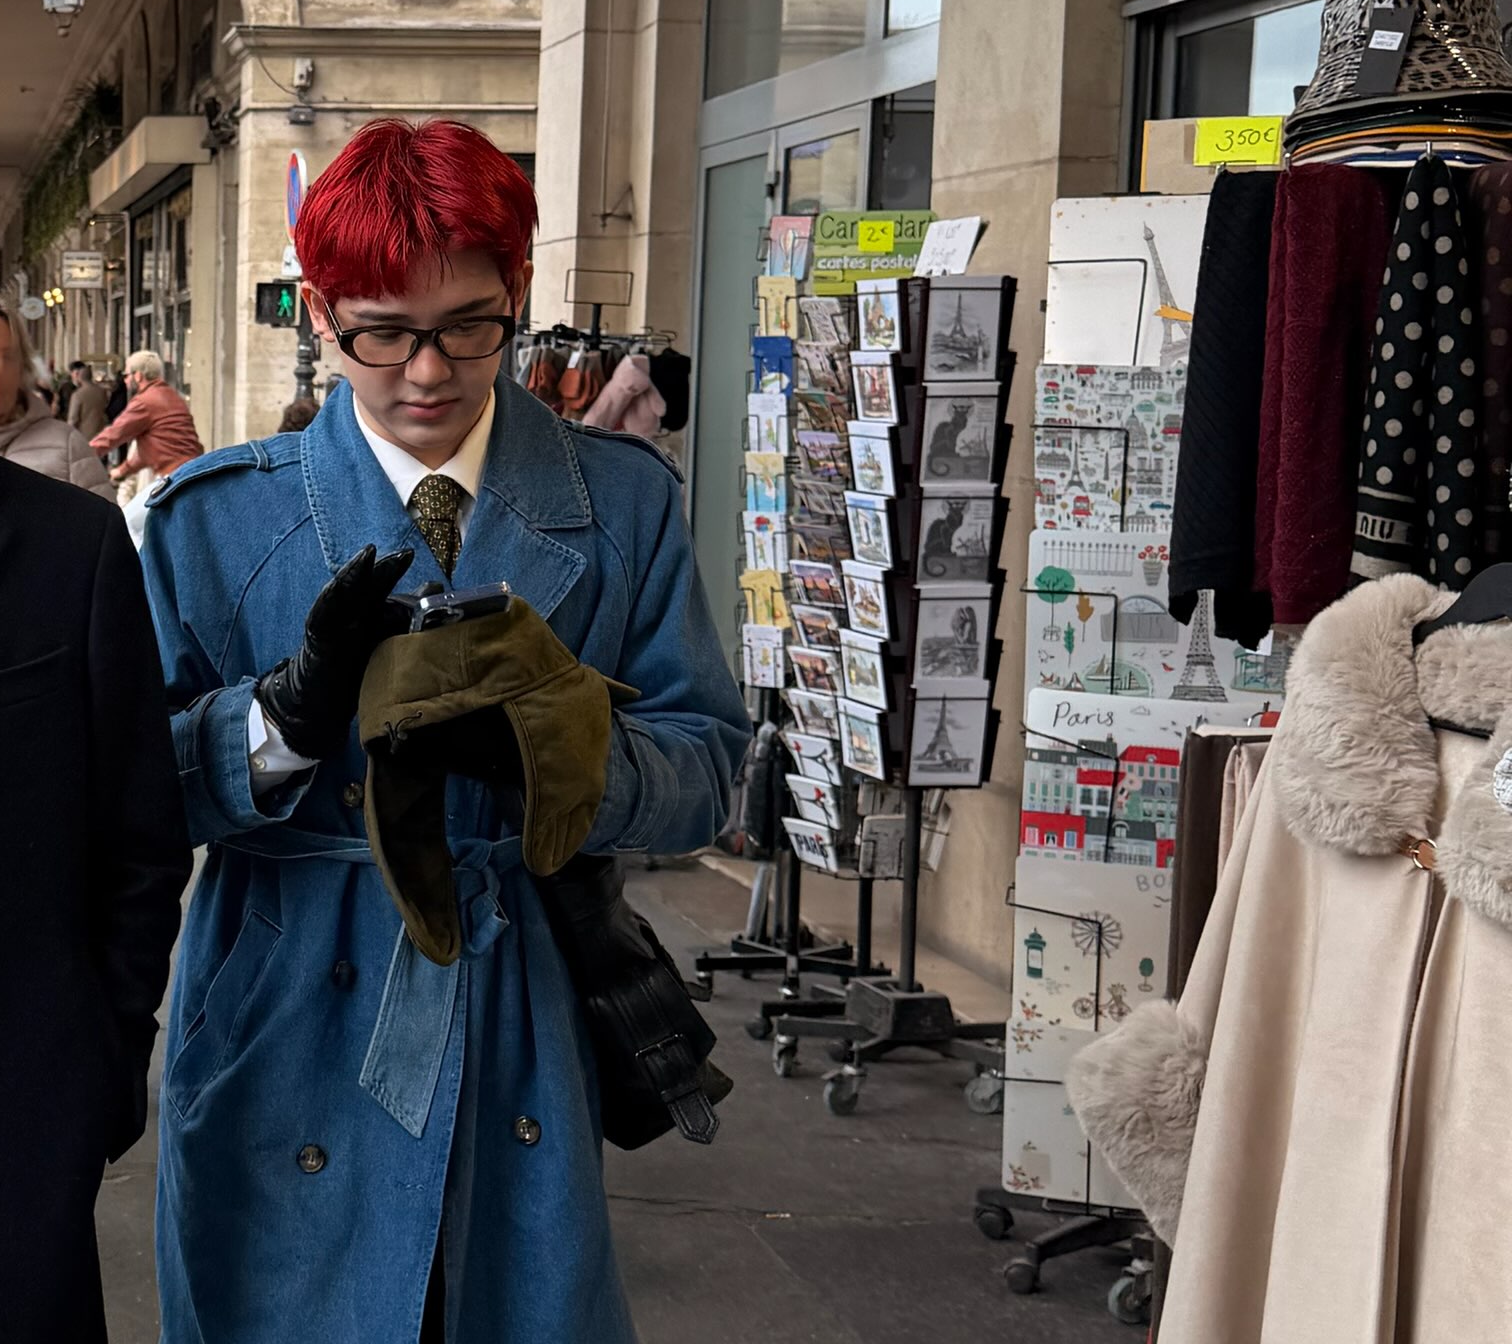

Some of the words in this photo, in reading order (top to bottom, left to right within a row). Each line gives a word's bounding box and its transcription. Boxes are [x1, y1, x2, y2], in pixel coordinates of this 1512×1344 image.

[817, 255, 867, 270] cartes
[870, 253, 919, 273] postal
[1052, 700, 1115, 728] Paris
